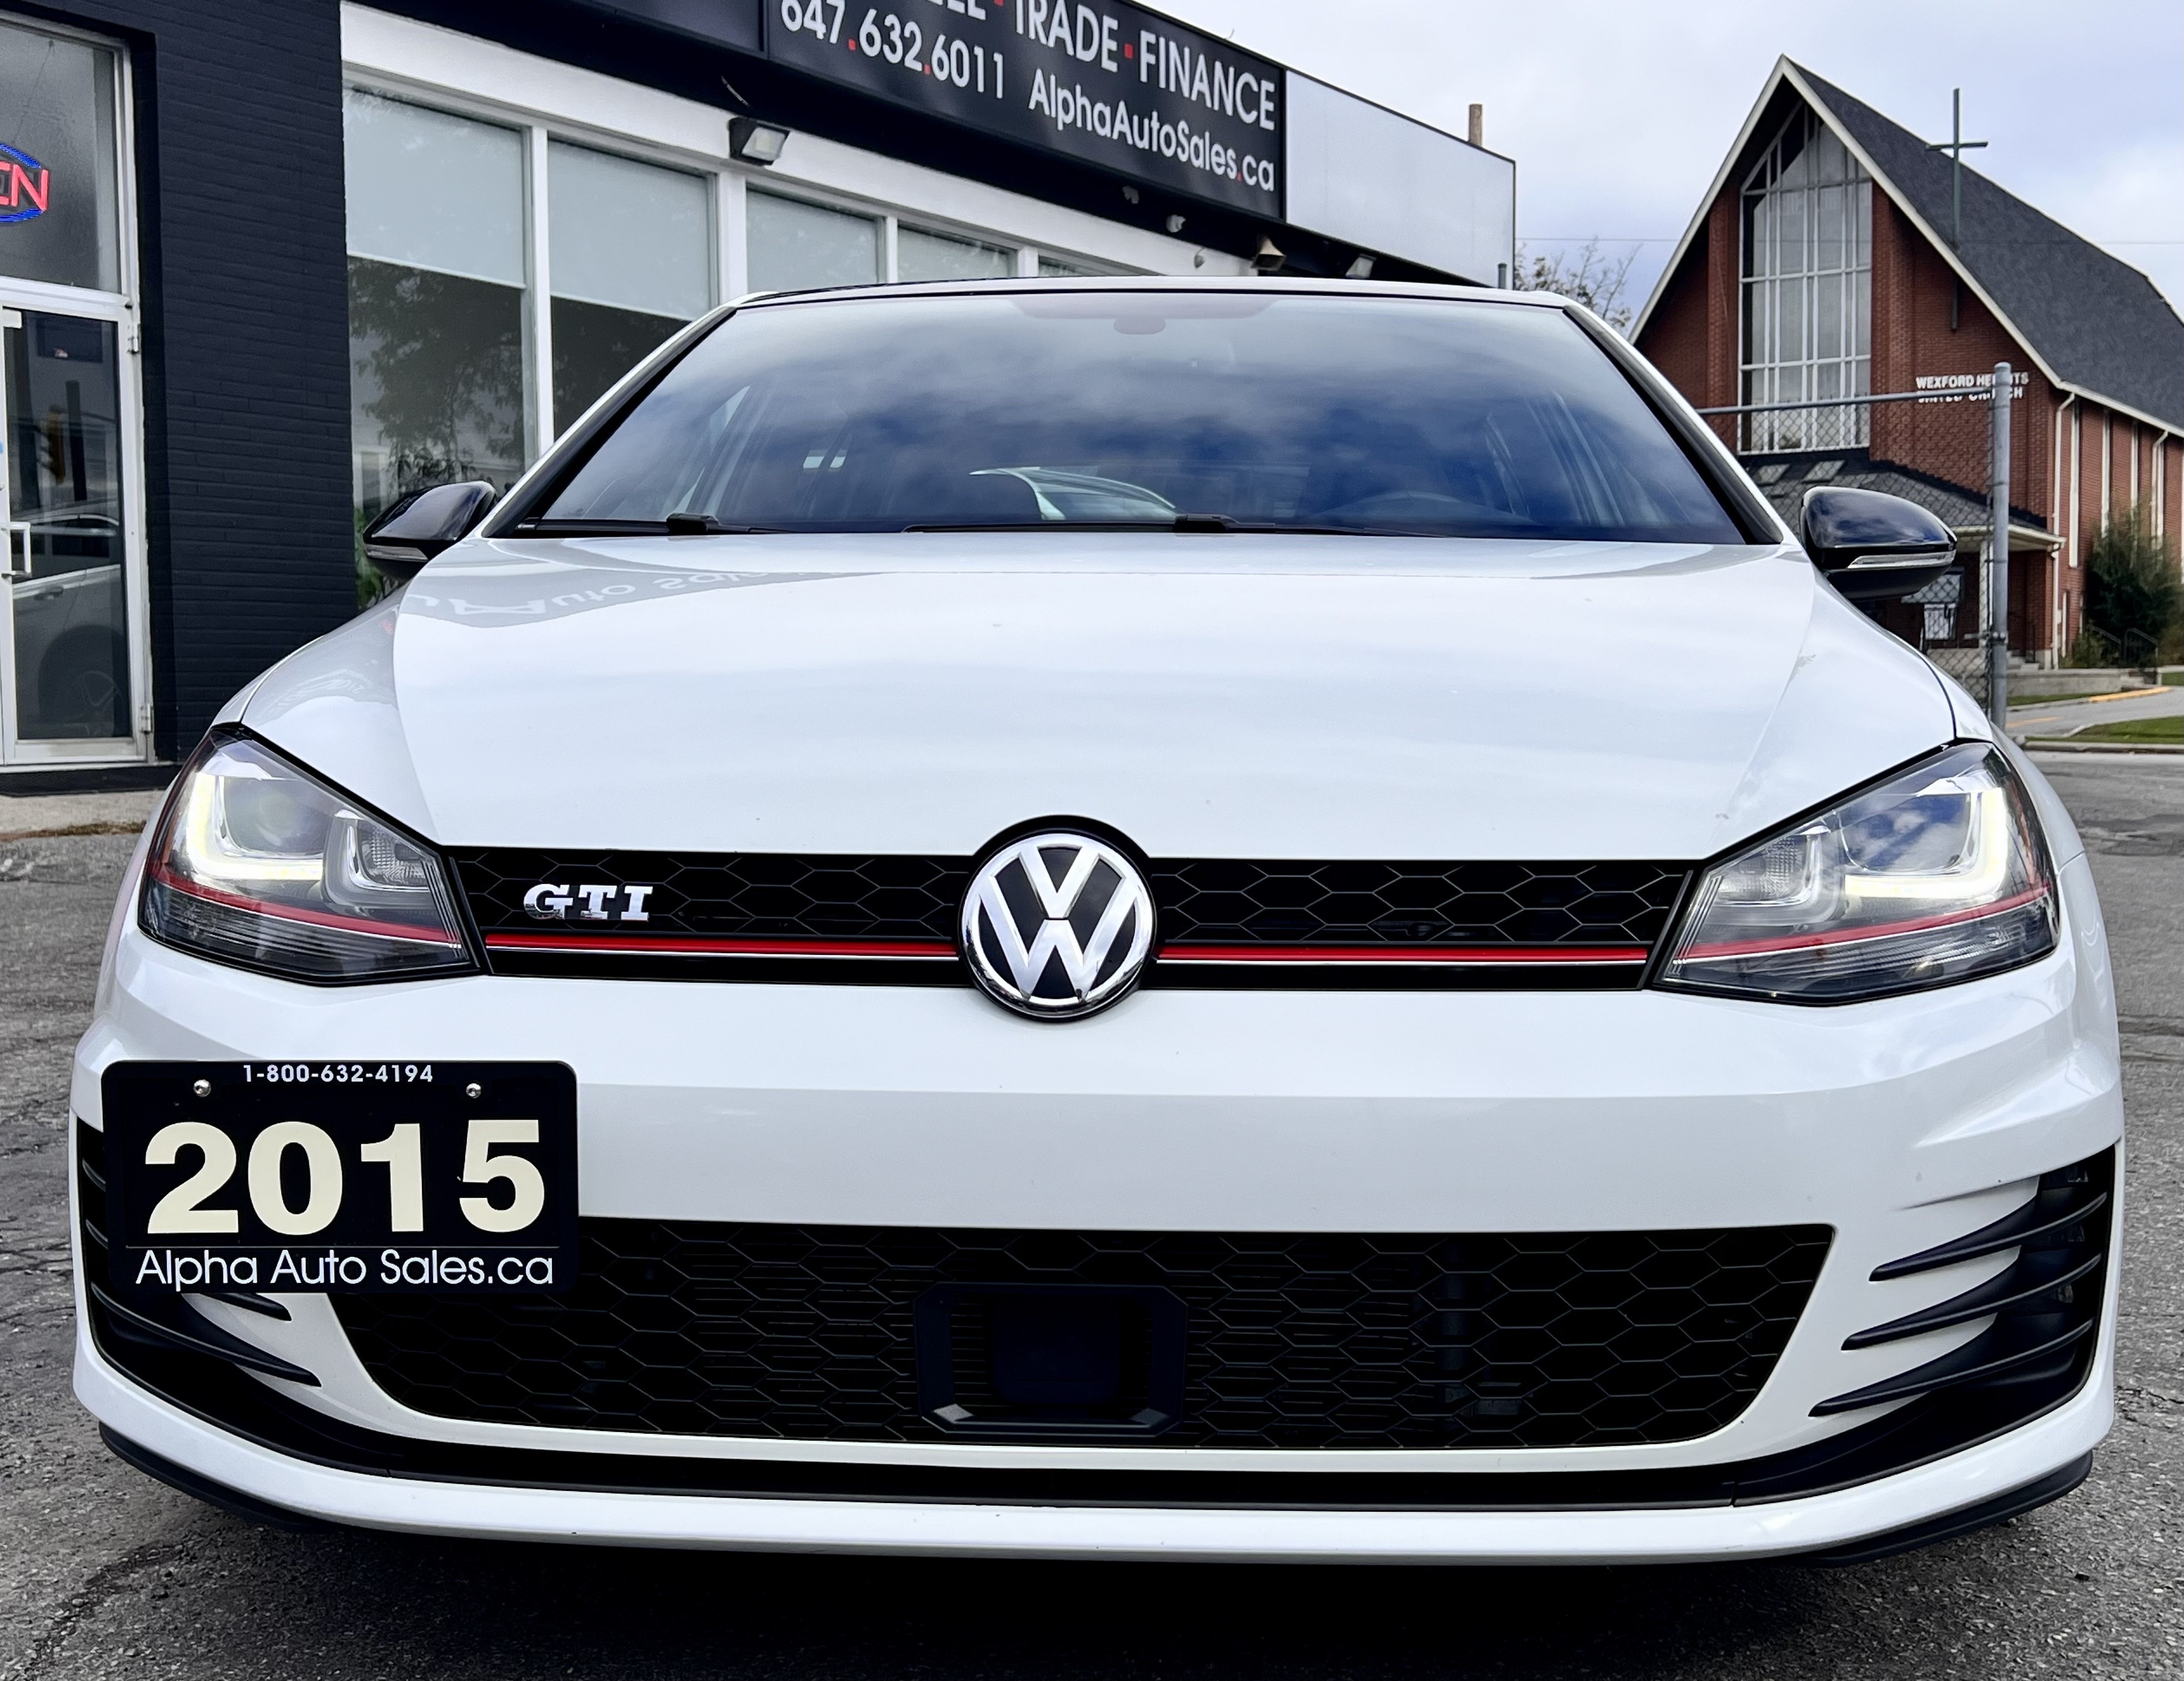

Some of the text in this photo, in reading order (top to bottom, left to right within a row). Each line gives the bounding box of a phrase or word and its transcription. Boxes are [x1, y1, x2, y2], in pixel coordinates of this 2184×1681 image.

[1139, 29, 1275, 131] FINANCE
[1028, 68, 1274, 191] AlphaAutoSales.ca
[1916, 372, 2029, 389] WEXFORD HEITS
[523, 883, 653, 922] GTI
[243, 1065, 434, 1083] 1-800-632-4194
[145, 1119, 545, 1235] 2015
[136, 1249, 554, 1291] Alpha Auto Sales.ca
